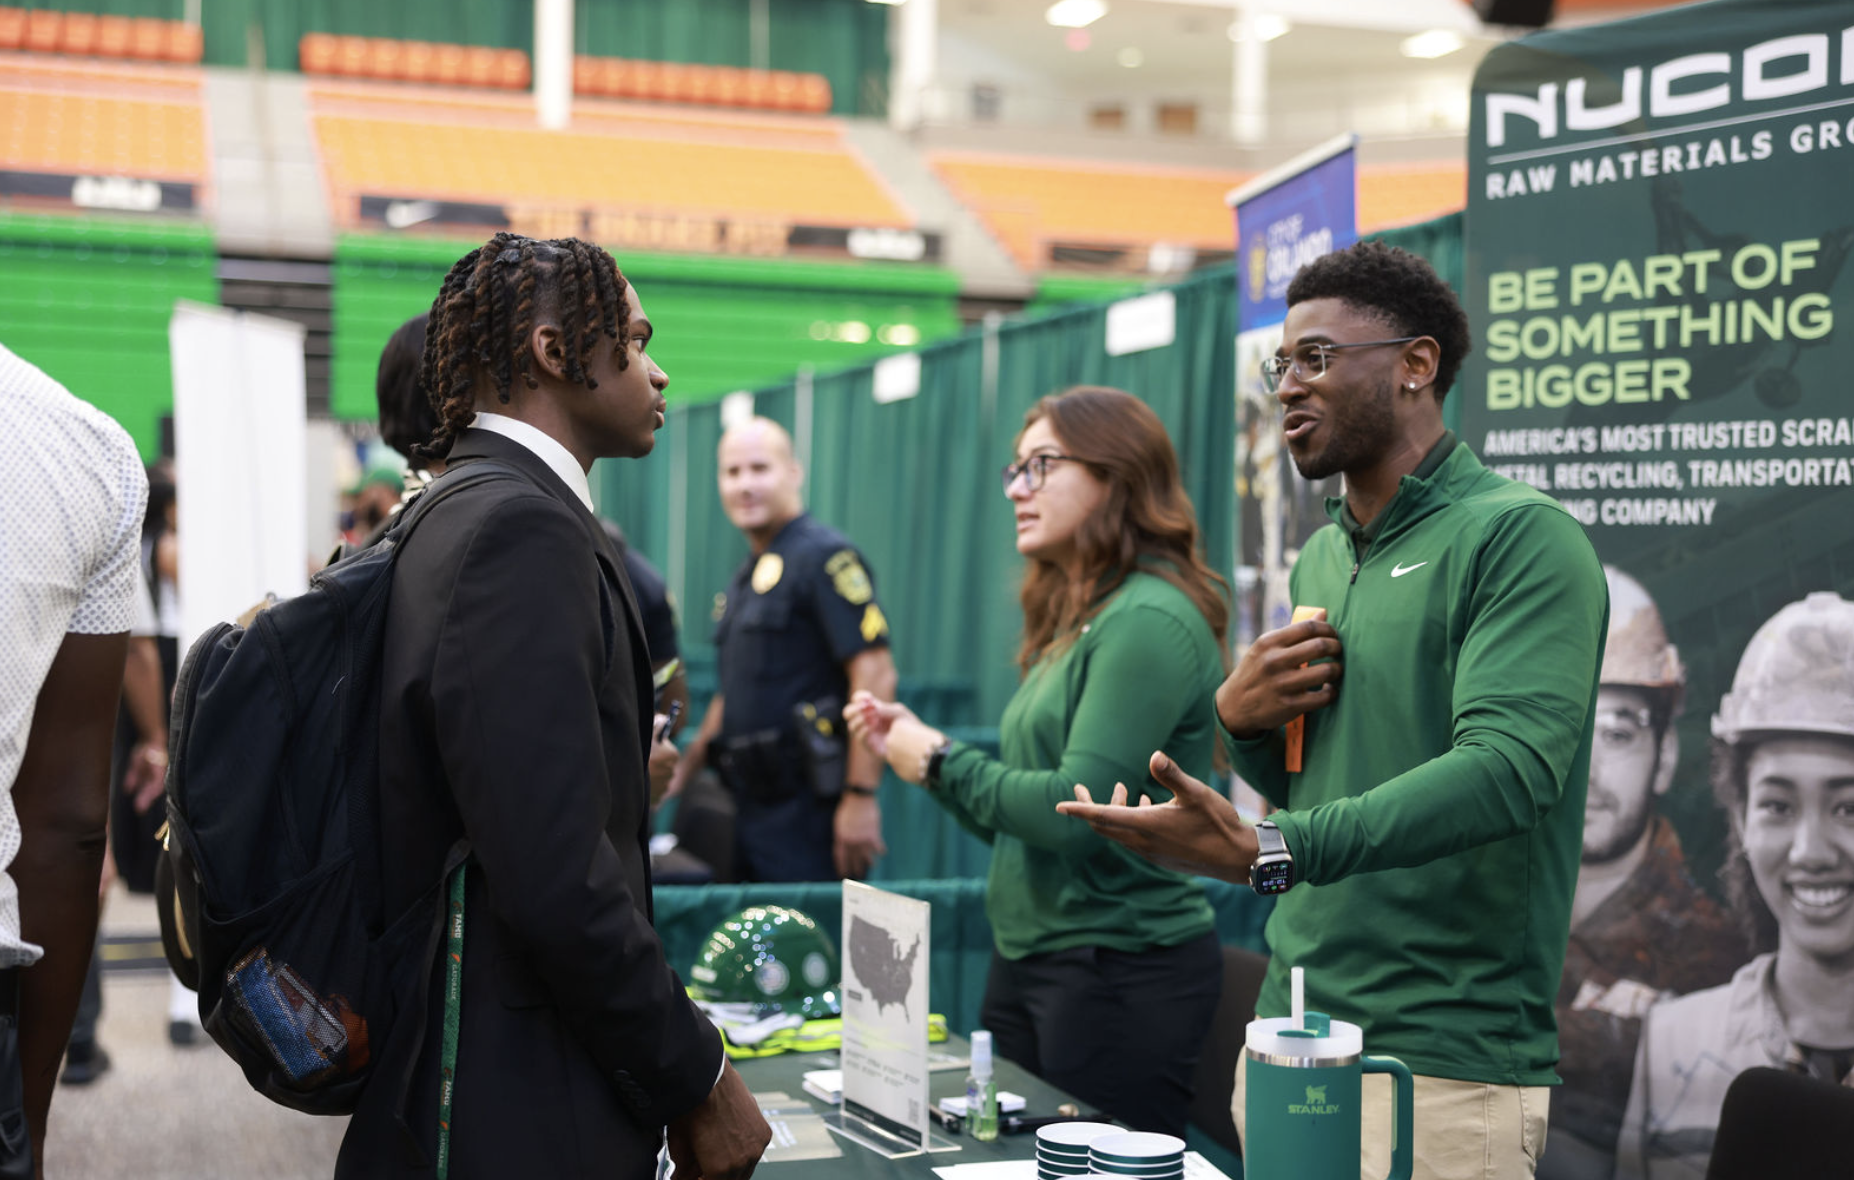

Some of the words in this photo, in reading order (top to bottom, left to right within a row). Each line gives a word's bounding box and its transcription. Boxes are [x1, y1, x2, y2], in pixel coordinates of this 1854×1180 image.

[1486, 26, 1854, 147] NUCO
[1486, 165, 1557, 199] RAW
[1570, 132, 1772, 188] MATERIALS
[1488, 267, 1559, 314] BE
[1570, 249, 1721, 306] PART
[1731, 238, 1820, 290] OF
[1486, 293, 1833, 362] SOMETHING
[1487, 357, 1692, 411] BIGGER
[1484, 426, 1598, 456] AMERICA'S
[1601, 424, 1665, 452] MOST
[1671, 420, 1776, 450] TRUSTED
[1781, 417, 1854, 447] SCRA
[1554, 460, 1684, 490] RECYCLING,
[1601, 498, 1716, 525] COMPANY
[1288, 1104, 1339, 1115] STANLEY
